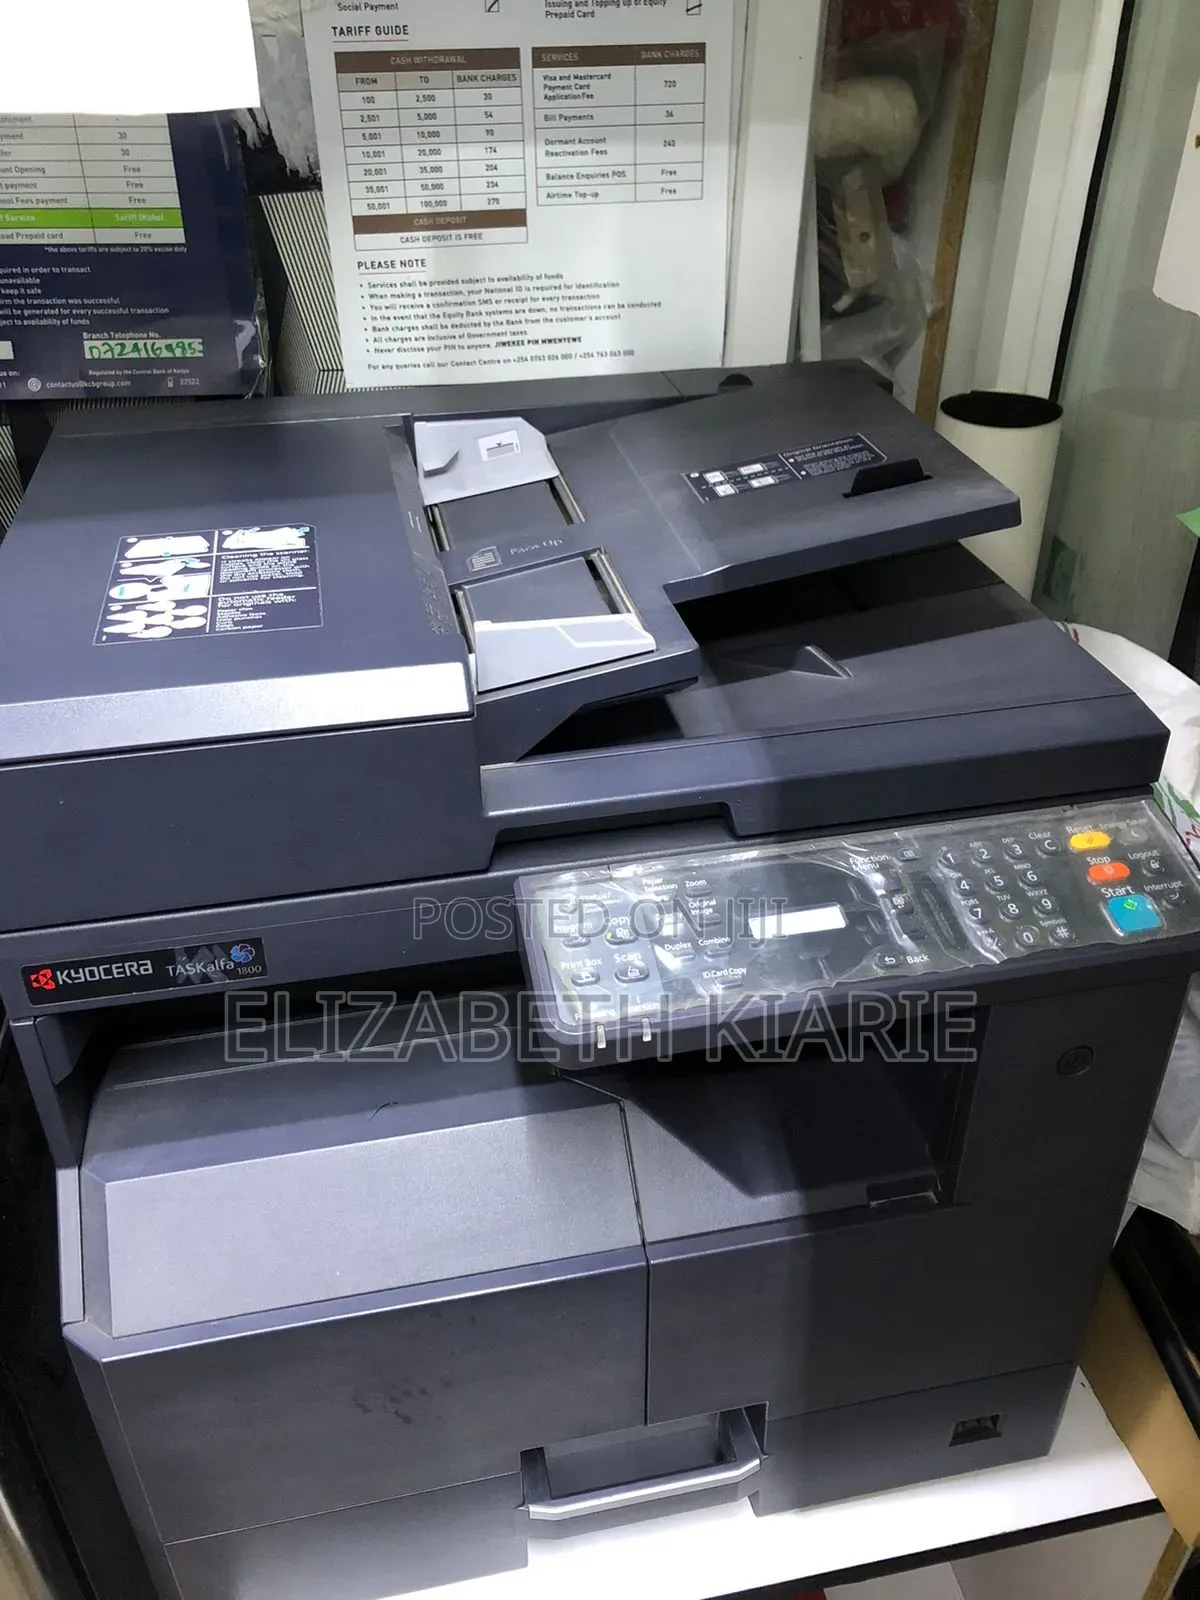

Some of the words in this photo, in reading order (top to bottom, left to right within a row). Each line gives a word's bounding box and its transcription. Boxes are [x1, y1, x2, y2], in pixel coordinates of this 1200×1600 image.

[337, 2, 362, 11] Social
[364, 1, 399, 11] Payment
[545, 0, 572, 8] Issuing
[545, 11, 575, 20] Prepaid
[576, 10, 595, 18] Card
[332, 26, 371, 37] TARIFF
[375, 25, 409, 35] GUIDE
[541, 53, 580, 62] SERVICES
[640, 51, 662, 59] BANK
[664, 49, 700, 58] CHARGES
[390, 56, 411, 65] CASH
[413, 55, 466, 64] WITHDRAWAL
[355, 77, 378, 85] FROM
[419, 76, 429, 84] TO
[457, 75, 479, 83] BANK
[480, 74, 517, 82] CHARGES
[543, 74, 557, 82] Visa
[573, 73, 611, 81] Mastercard
[543, 84, 572, 92] Payment
[664, 80, 676, 88] 720
[362, 96, 375, 104] 100
[415, 94, 436, 103] 2,500
[483, 93, 493, 101] 30
[544, 93, 581, 101] Application
[360, 114, 380, 123] 2,501
[417, 112, 437, 121] 5,000
[484, 111, 493, 119] 54
[543, 114, 557, 122] Bill
[558, 113, 594, 122] Payments
[118, 132, 128, 140] 30
[362, 132, 382, 141] 5,001
[416, 130, 440, 139] 10,000
[485, 129, 494, 137] 90
[545, 138, 576, 146] Dormant
[578, 136, 606, 145] Account
[120, 148, 130, 156] 30
[362, 150, 385, 159] 10,001
[418, 148, 442, 157] 20,000
[485, 146, 497, 154] 174
[545, 149, 588, 157] Reactivation
[591, 148, 608, 156] Fees
[14, 166, 46, 174] Opening
[363, 168, 387, 176] 20,001
[419, 165, 443, 174] 35,000
[485, 163, 498, 172] 204
[546, 173, 574, 181] Balance
[576, 171, 610, 181] Enquiries
[612, 170, 626, 178] POS
[5, 182, 37, 190] payment
[365, 185, 389, 194] 35,001
[420, 182, 444, 191] 50,000
[546, 191, 572, 199] Airtime
[574, 190, 599, 199] Top-up
[661, 187, 677, 195] Free
[36, 198, 68, 206] payment
[128, 196, 146, 204] Free
[420, 199, 448, 208] 100,000
[487, 197, 500, 205] 270
[366, 202, 390, 211] 50,001
[5, 213, 35, 222] Service
[413, 217, 434, 226] CASH
[436, 216, 466, 225] DEPOSIT
[15, 232, 45, 241] Prepaid
[134, 231, 152, 239] Free
[400, 235, 421, 243] CASH
[422, 234, 453, 243] DEPOSIT
[454, 233, 462, 241] IS
[464, 232, 483, 241] FREE
[357, 261, 396, 270] PLEASE
[399, 259, 427, 268] NOTE
[368, 282, 398, 290] Services
[399, 280, 417, 288] shall
[429, 278, 459, 288] provided
[461, 277, 486, 286] subject
[83, 296, 120, 304] successful
[23, 308, 59, 316] generated
[93, 307, 130, 315] successful
[110, 331, 148, 339] Telephone
[541, 336, 582, 345] MWENYEWE
[46, 380, 131, 389] contactus@kcbgroup.com
[1066, 825, 1092, 834] Reset
[1028, 831, 1051, 840] Clear
[1011, 844, 1022, 855] 3
[1044, 840, 1056, 850] C
[946, 853, 955, 863] 1
[979, 848, 992, 859] 2
[1128, 850, 1159, 860] Logout
[850, 853, 889, 864] Function
[1087, 856, 1111, 865] Stop
[852, 863, 880, 871] Menu
[1027, 870, 1037, 881] 6
[685, 879, 707, 887] Zoom
[960, 880, 970, 890] 4
[993, 875, 1004, 886] 5
[1144, 881, 1184, 892] Interrupt
[1101, 885, 1134, 898] Start
[1041, 898, 1052, 909] 9
[973, 908, 982, 918] 7
[1007, 903, 1019, 914] 8
[698, 937, 731, 946] Combine
[1023, 932, 1033, 943] 0
[664, 942, 692, 951] Duplex
[613, 952, 642, 963] Scan
[906, 953, 929, 964] Back
[560, 960, 583, 970] Print
[585, 957, 603, 967] Box
[56, 959, 153, 985] KYOCERA
[166, 960, 234, 977] TASKalfa
[236, 964, 262, 975] 1800
[711, 969, 728, 977] Card
[728, 967, 747, 976] Copy
